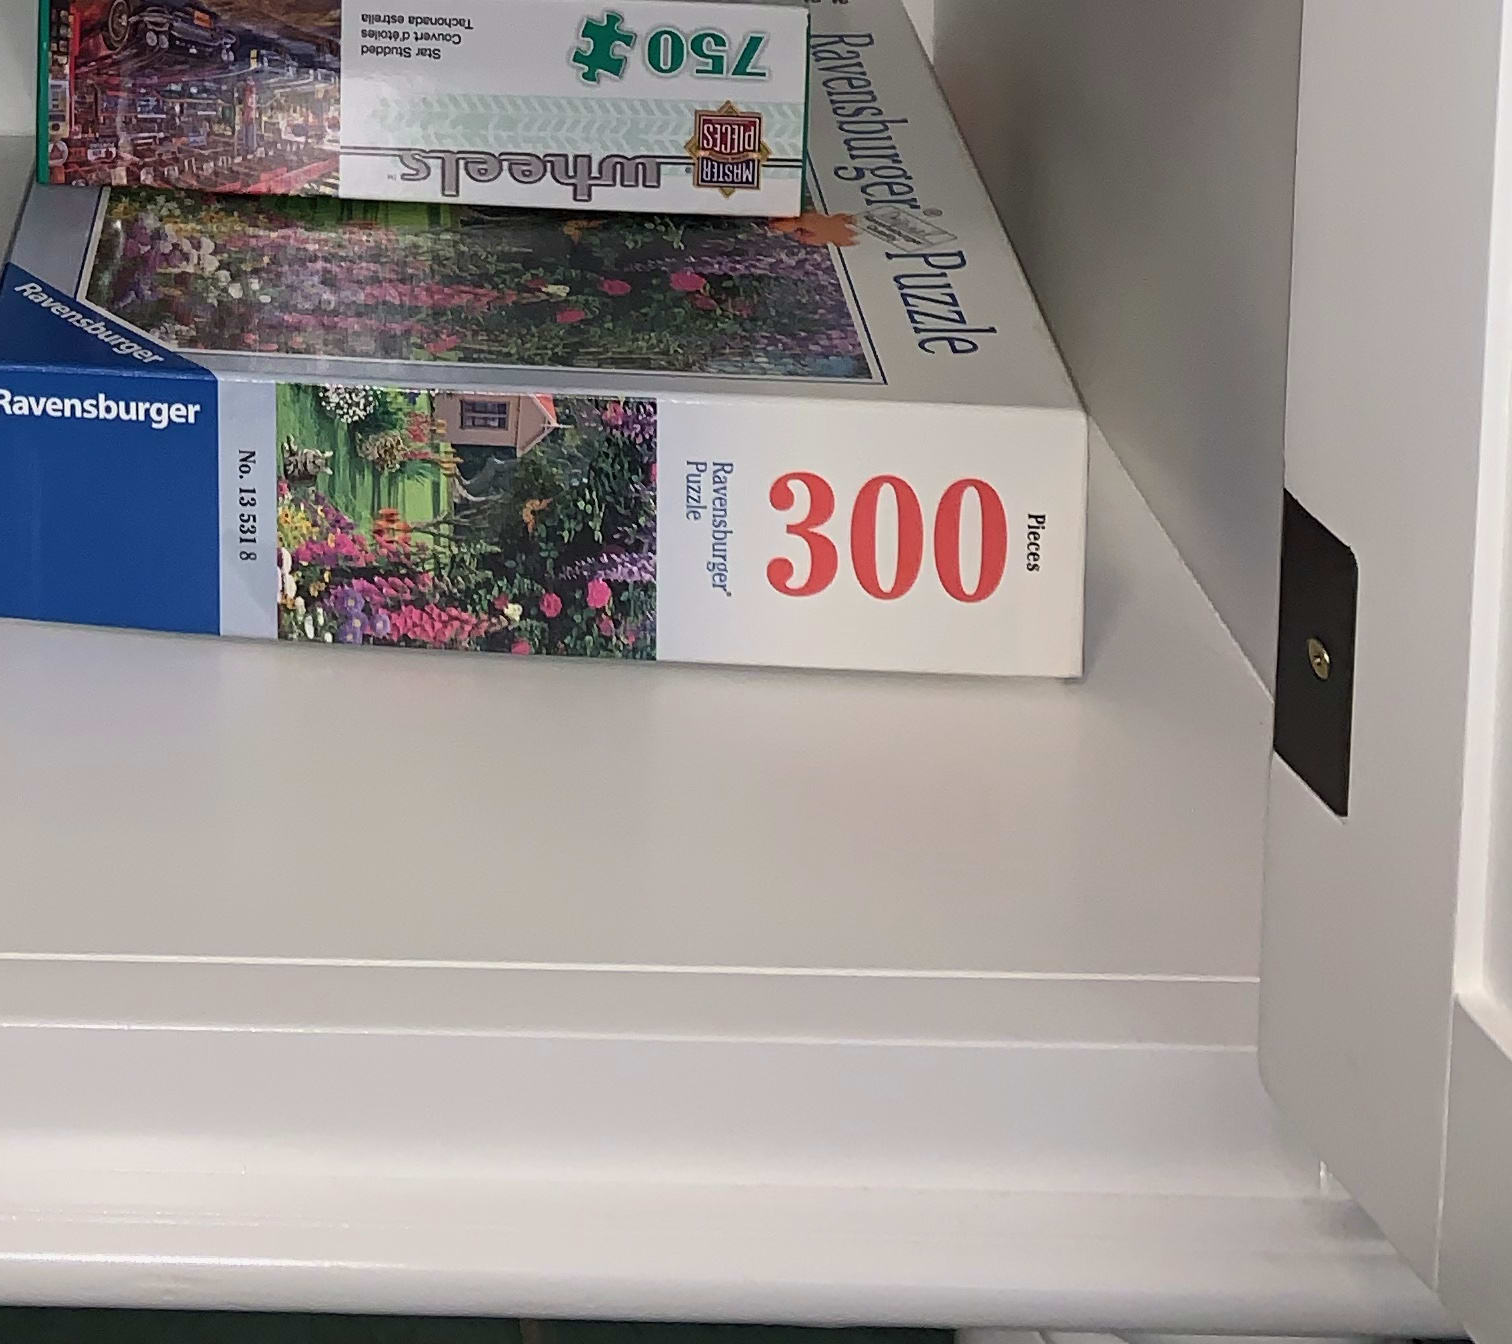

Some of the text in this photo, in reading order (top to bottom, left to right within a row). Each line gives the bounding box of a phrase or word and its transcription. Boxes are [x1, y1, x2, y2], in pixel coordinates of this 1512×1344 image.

[360, 12, 475, 31] Tachonada estrella
[413, 31, 463, 45] Couvert
[360, 44, 442, 60] Star Studded
[643, 27, 772, 81] 750
[702, 122, 756, 153] PIECES
[398, 146, 662, 203] wheels
[701, 158, 754, 183] MASTER
[809, 31, 922, 211] Ravensburger
[884, 248, 997, 359] Puzzle
[12, 278, 167, 367] Ravensburger
[237, 448, 258, 563] No. 13 531 8
[685, 459, 708, 522] Puzzle
[711, 460, 735, 593] Ravensburger
[765, 469, 1011, 604] 300
[1027, 511, 1047, 574] Pieces
